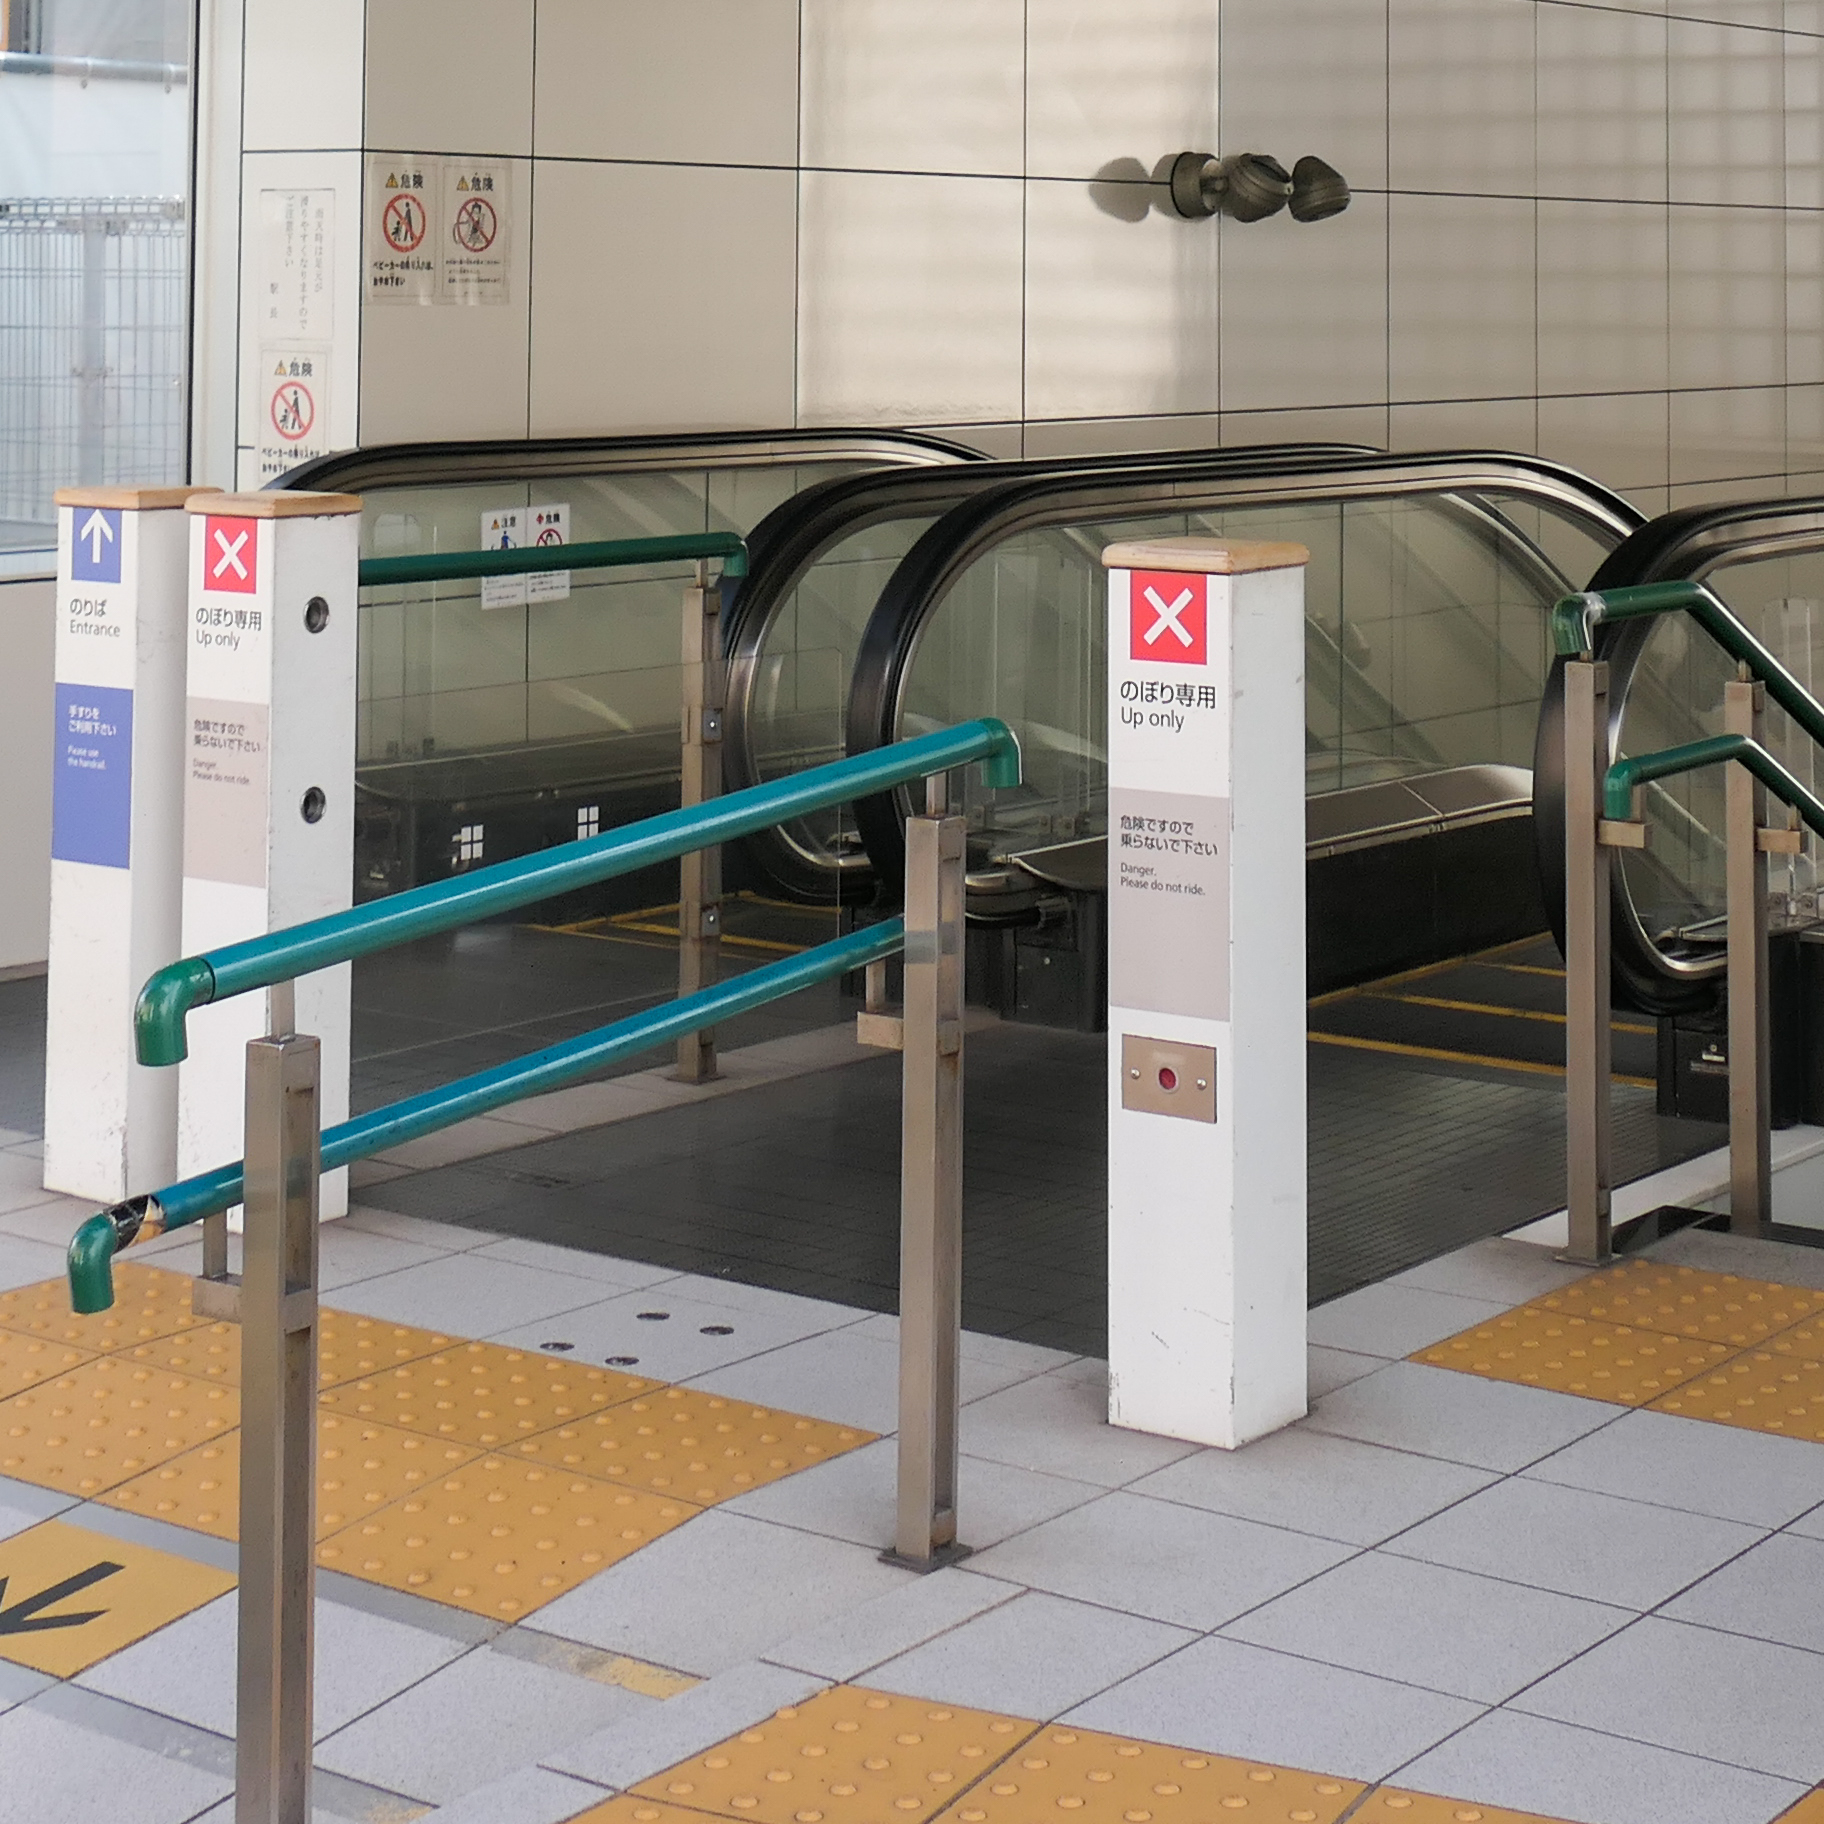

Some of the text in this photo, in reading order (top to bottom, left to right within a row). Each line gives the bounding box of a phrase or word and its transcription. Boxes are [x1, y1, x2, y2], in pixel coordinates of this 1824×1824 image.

[401, 172, 424, 189] 危険
[470, 175, 494, 192] 危険
[289, 360, 313, 377] 危険
[70, 598, 107, 617] のりば
[70, 619, 121, 638] Entrance
[195, 607, 263, 632] のぼり専用
[195, 629, 241, 652] Up only
[1120, 680, 1216, 709] のぼり専用
[69, 704, 100, 720] 手すりを
[1120, 706, 1185, 733] Up only
[68, 719, 117, 736] ご利用下さい
[194, 718, 246, 737] 危険ですので
[193, 734, 261, 753] 乗らないで下さい
[1120, 814, 1194, 836] 危険ですので
[1120, 833, 1218, 856] 乗らないで下さい
[1120, 862, 1157, 877] Danger.
[1120, 878, 1206, 896] Please do not ride.
